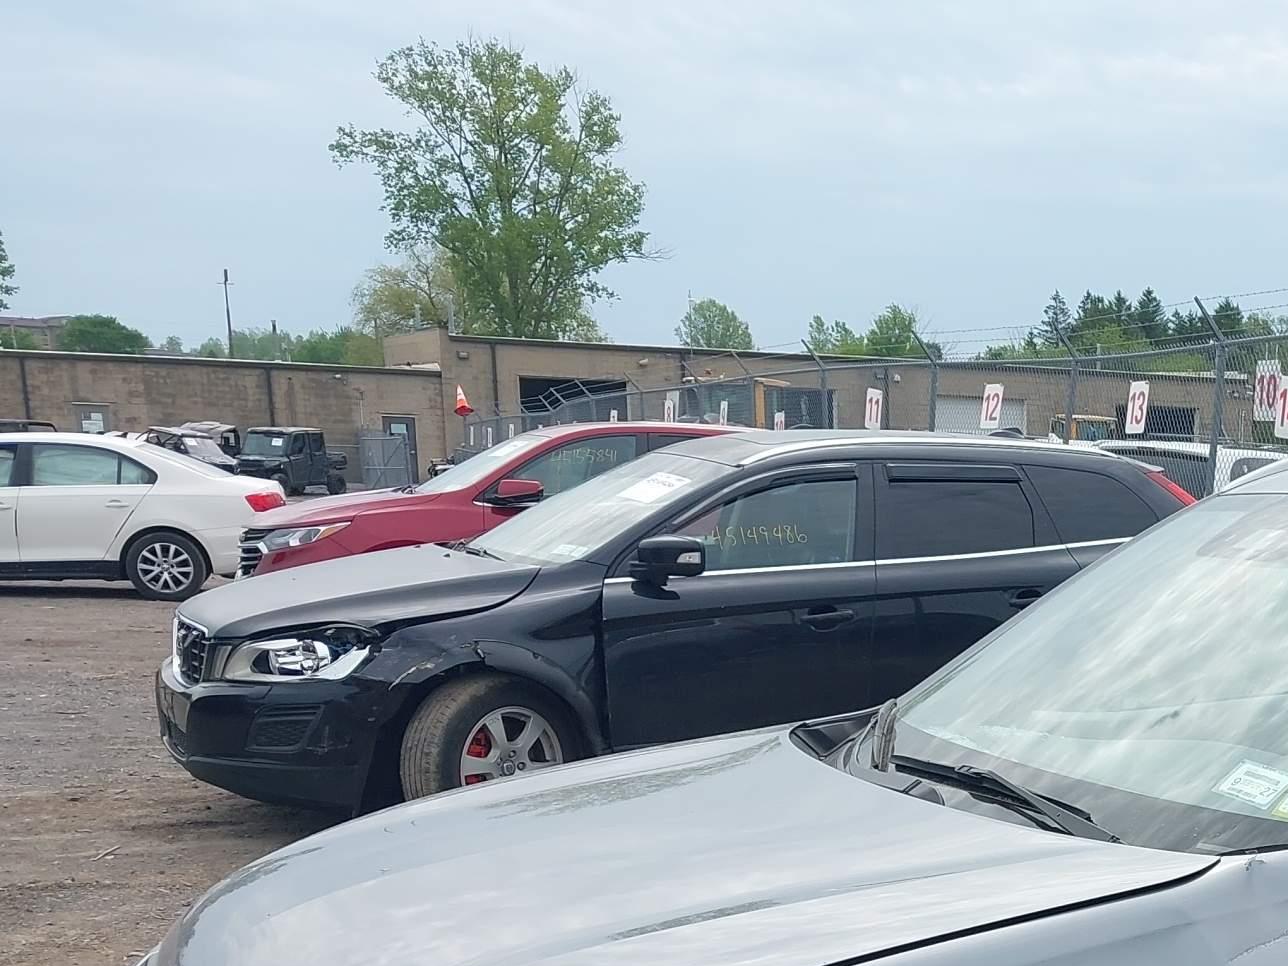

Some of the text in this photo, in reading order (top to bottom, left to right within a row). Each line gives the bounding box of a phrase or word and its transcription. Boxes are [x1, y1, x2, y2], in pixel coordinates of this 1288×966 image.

[868, 396, 880, 424] 11
[984, 392, 1000, 422] 12
[1130, 391, 1146, 425] 13
[711, 524, 808, 551] 45149486
